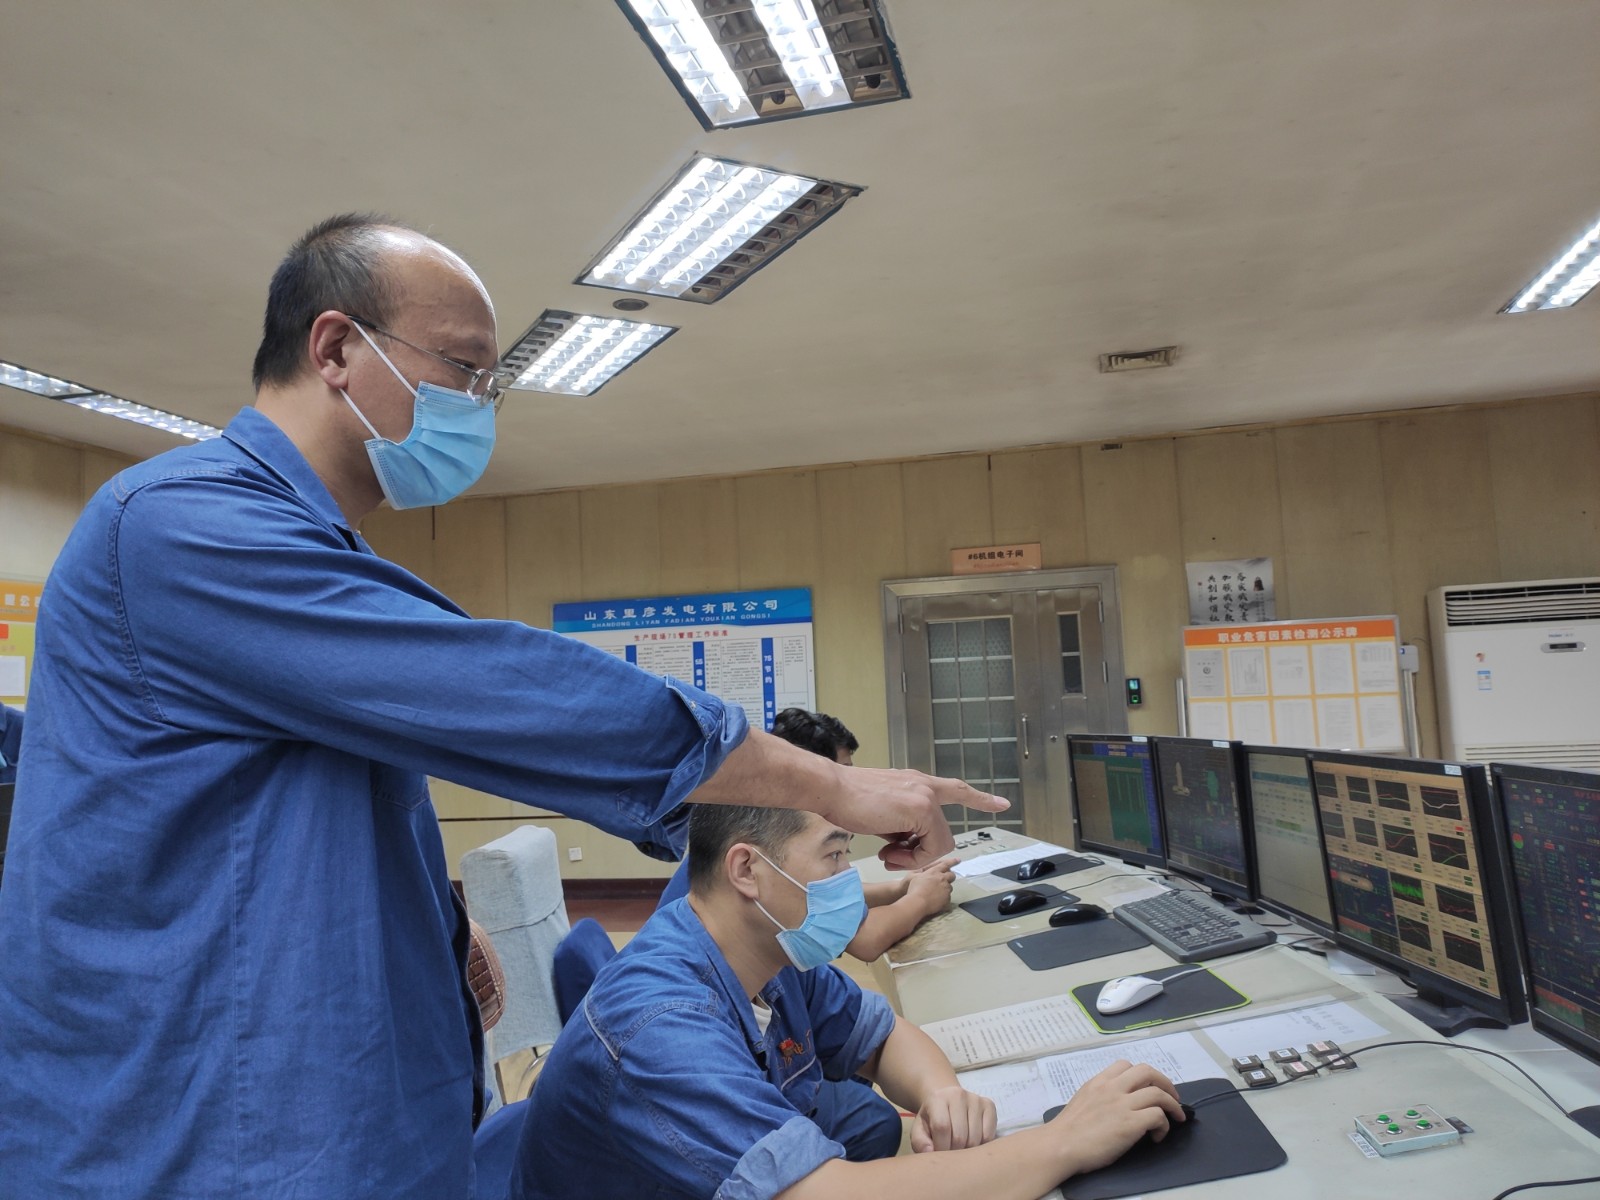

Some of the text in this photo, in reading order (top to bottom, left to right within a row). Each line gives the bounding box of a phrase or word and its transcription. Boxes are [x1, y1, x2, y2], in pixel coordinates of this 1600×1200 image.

[584, 599, 778, 621] 山东里彦发电有限公司
